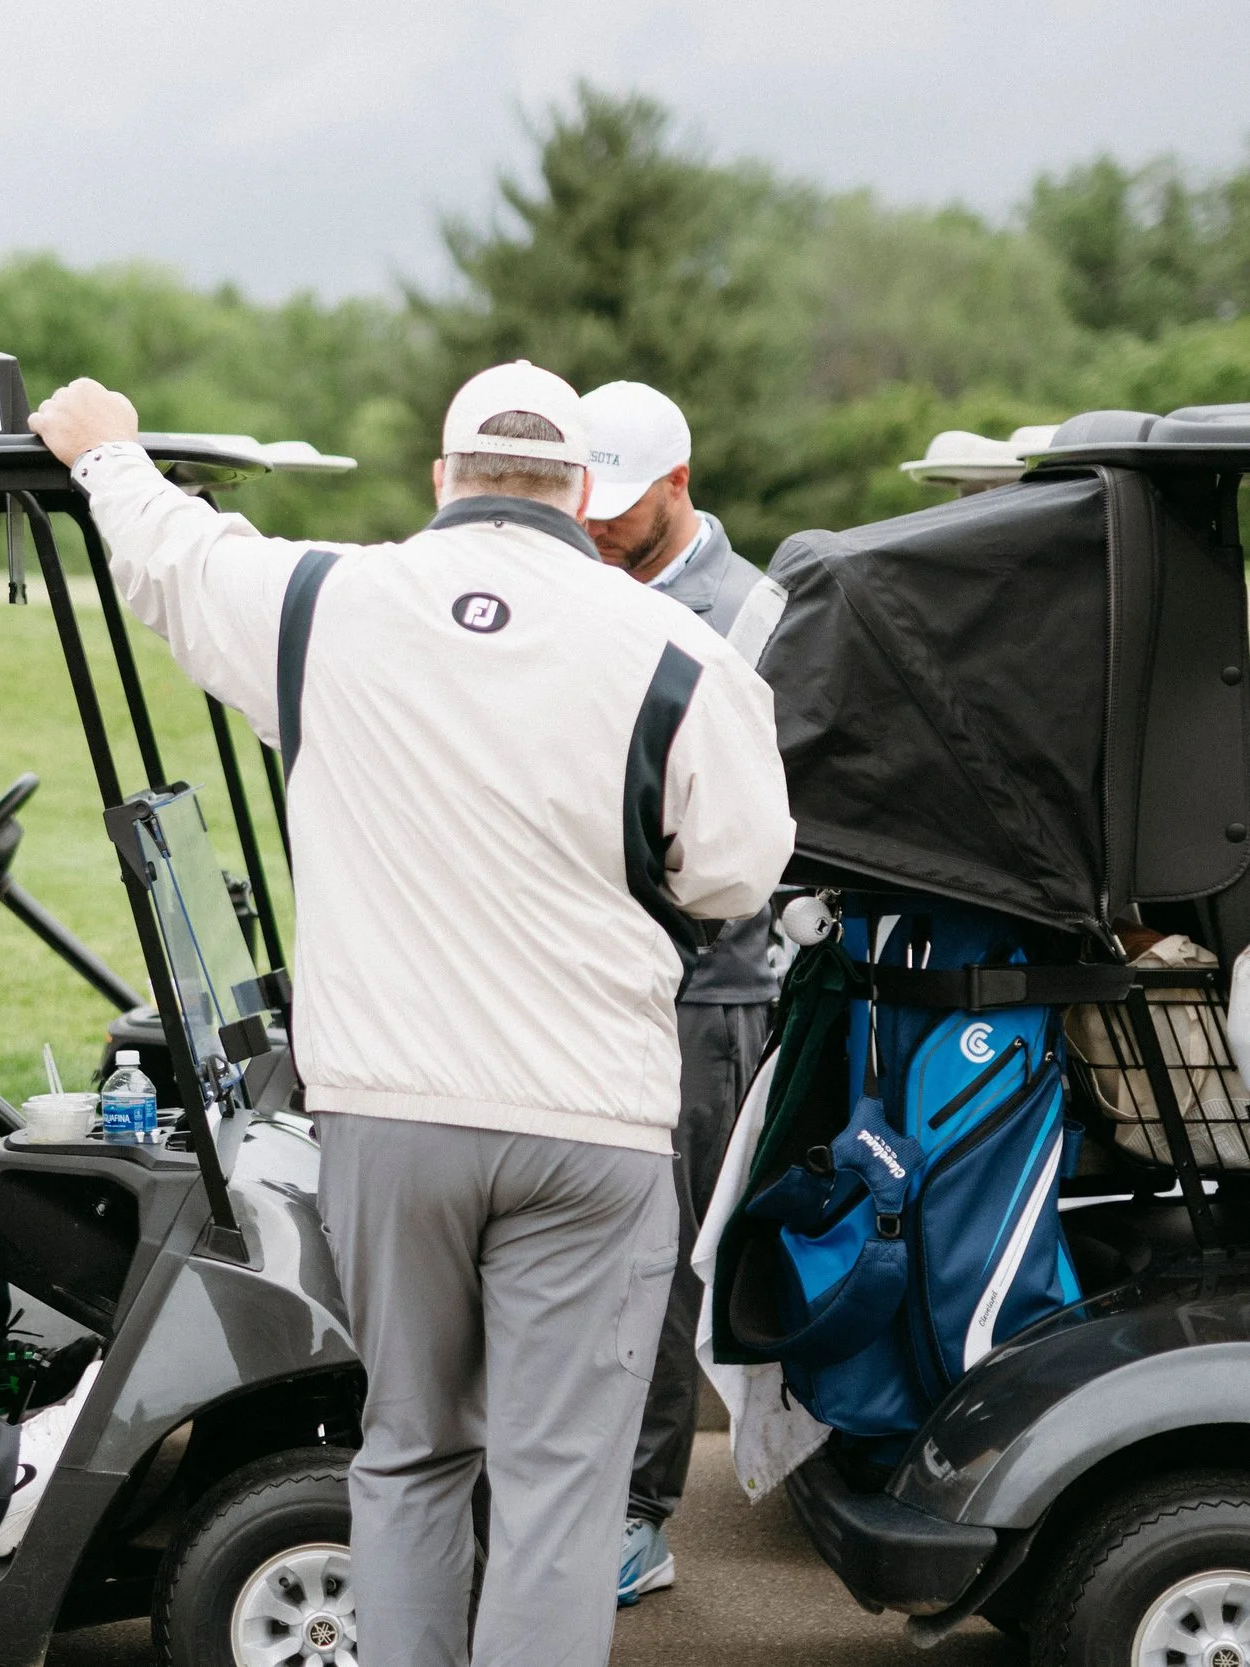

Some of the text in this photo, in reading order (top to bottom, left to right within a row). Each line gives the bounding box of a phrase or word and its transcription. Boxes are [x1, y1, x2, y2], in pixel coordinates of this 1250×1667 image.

[589, 450, 620, 466] SOTA
[103, 1113, 132, 1124] QUAFINA
[857, 1129, 906, 1178] Cleveland
